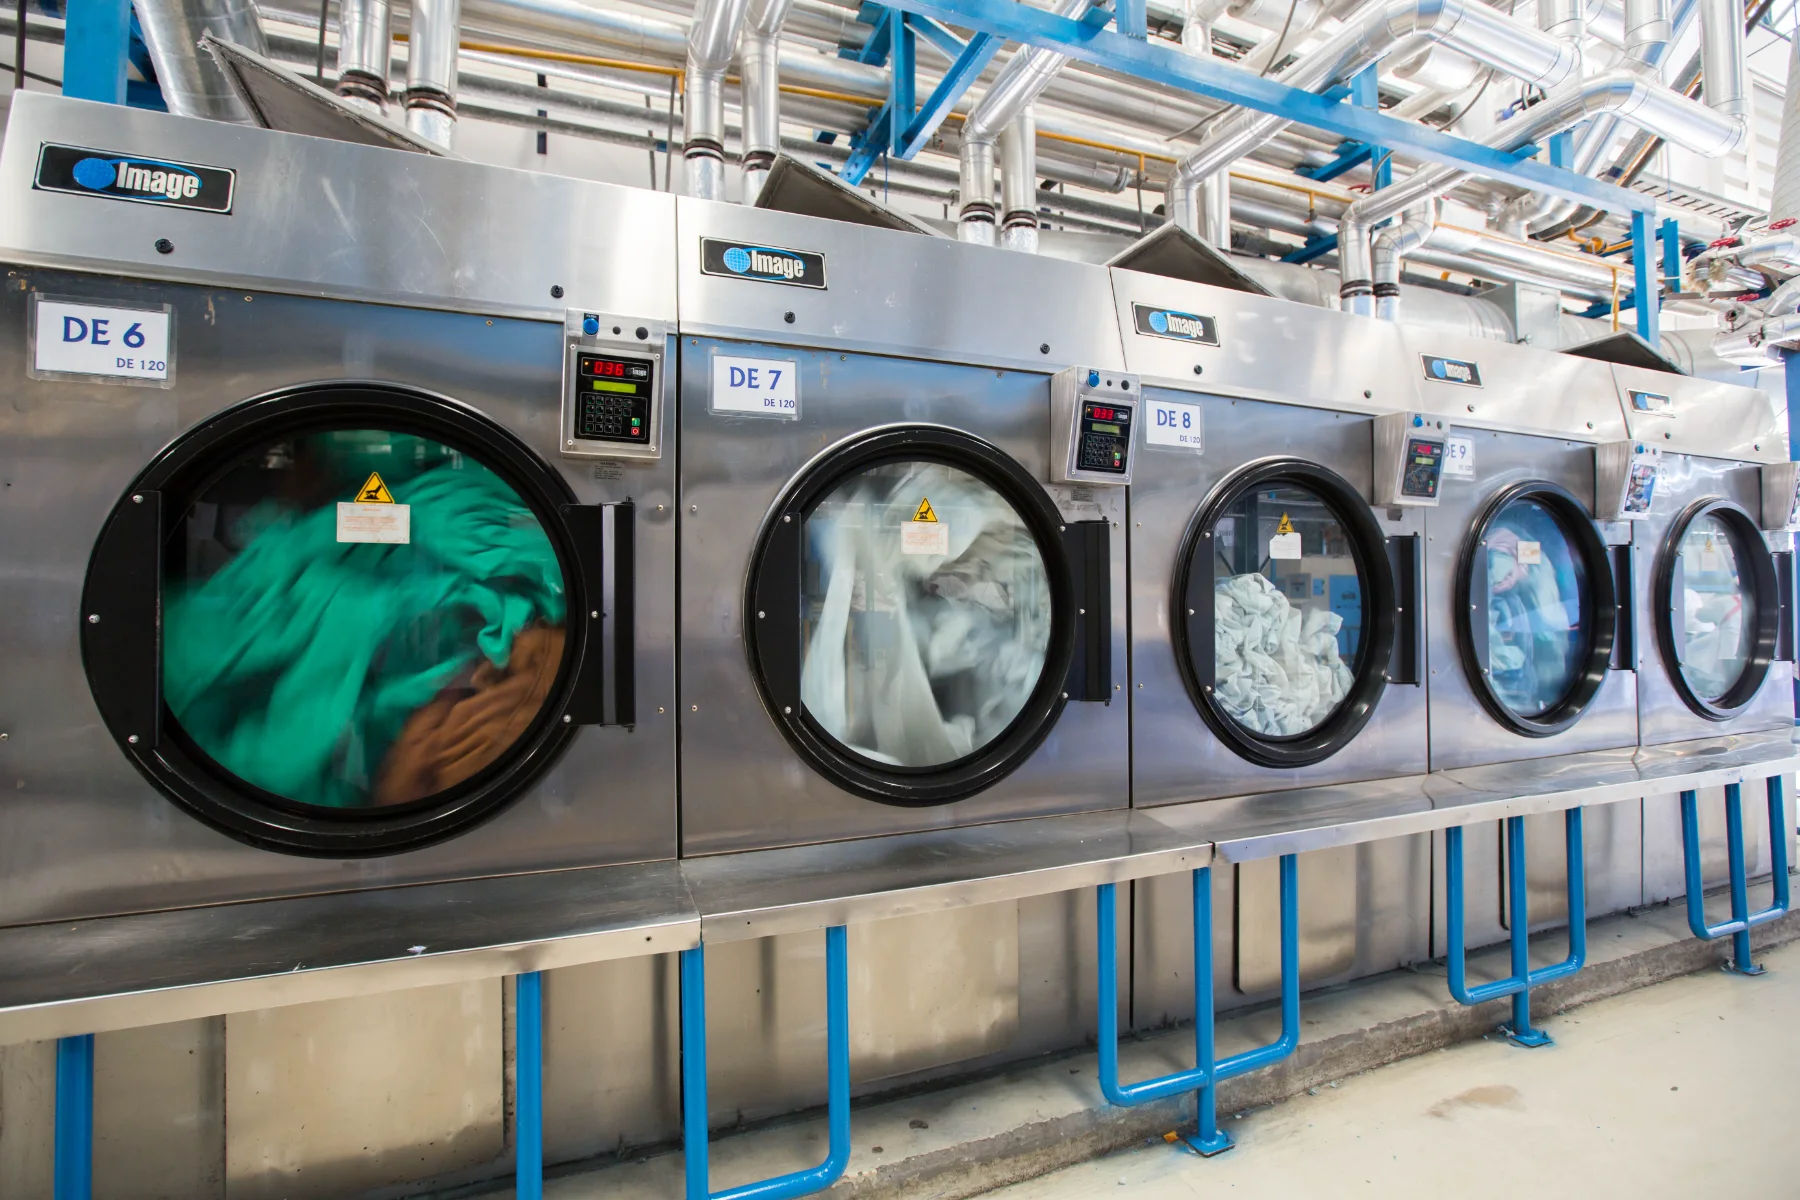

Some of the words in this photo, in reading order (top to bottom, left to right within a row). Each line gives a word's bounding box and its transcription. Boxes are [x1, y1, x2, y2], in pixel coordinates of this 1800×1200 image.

[116, 162, 199, 199] Image
[751, 250, 804, 279] Image
[62, 316, 111, 345] DE
[123, 323, 145, 348] 6
[1167, 312, 1204, 338] Image
[116, 358, 134, 369] DE
[141, 360, 165, 371] 120
[593, 361, 624, 376] 036
[729, 366, 760, 389] DE
[768, 369, 782, 390] 7
[764, 398, 776, 407] DE
[779, 399, 795, 408] 120
[1093, 407, 1114, 420] 033
[1157, 408, 1177, 427] DE
[1182, 411, 1191, 429] 8
[1460, 445, 1466, 459] 9
